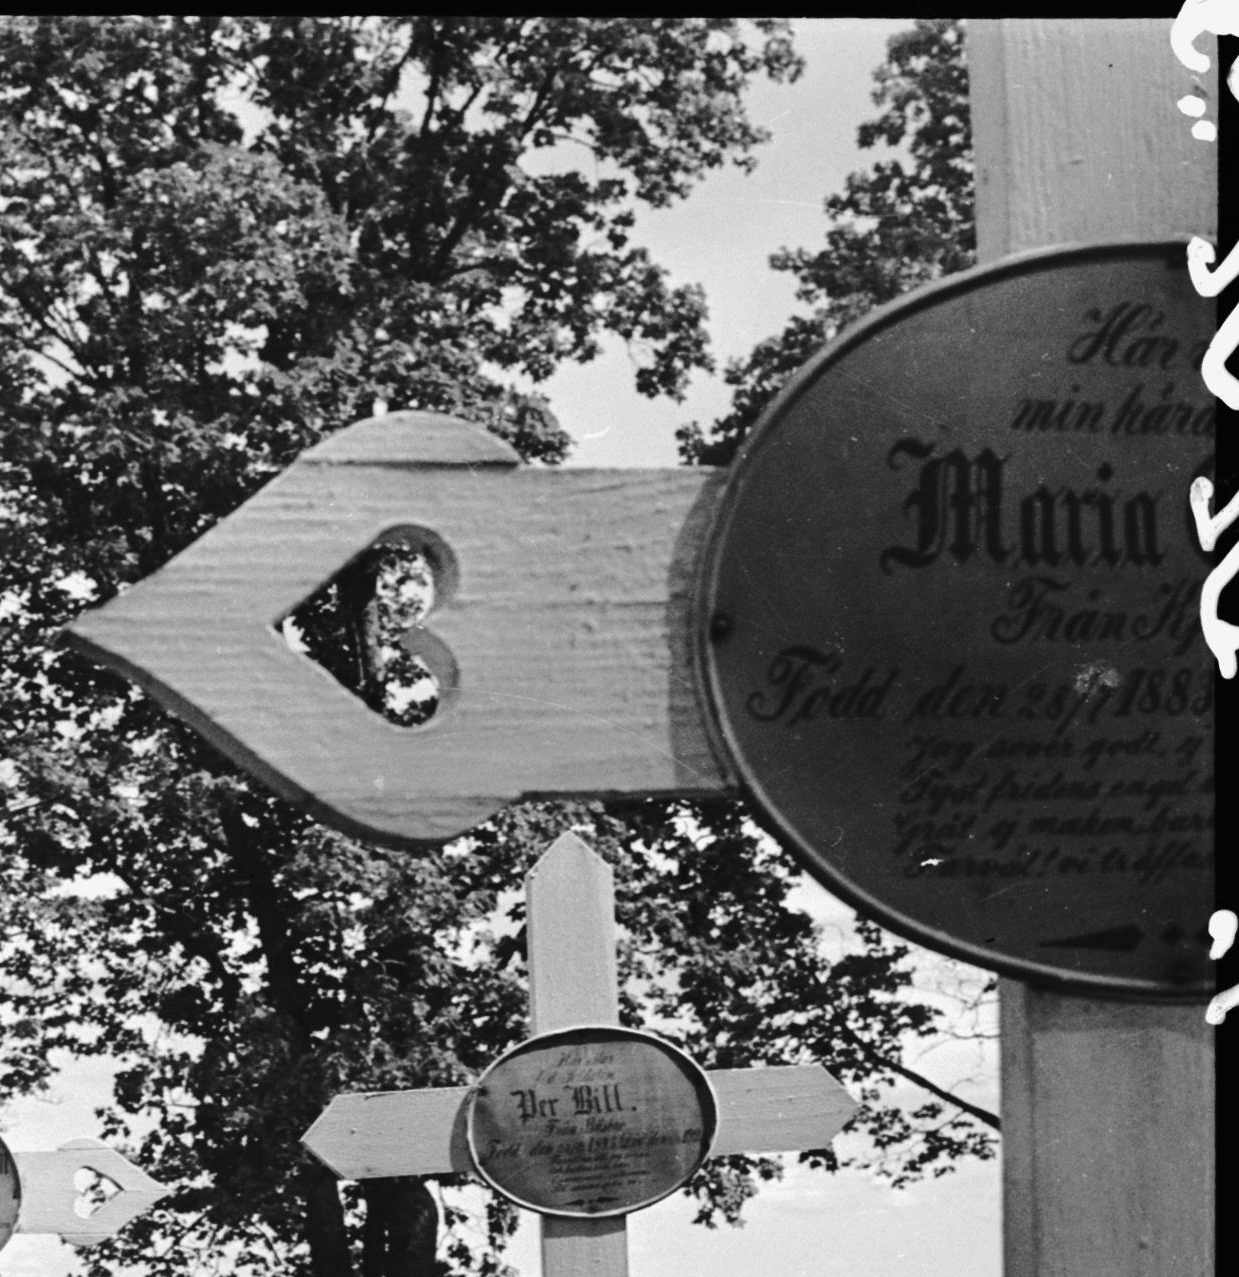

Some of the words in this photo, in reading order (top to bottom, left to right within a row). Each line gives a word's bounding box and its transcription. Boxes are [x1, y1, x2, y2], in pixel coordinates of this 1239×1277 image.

[1011, 383, 1106, 432] min
[879, 436, 1165, 576] Maria
[990, 576, 1127, 646] Från
[747, 645, 900, 727] Född
[911, 665, 1010, 720] den
[510, 1088, 560, 1124] Per
